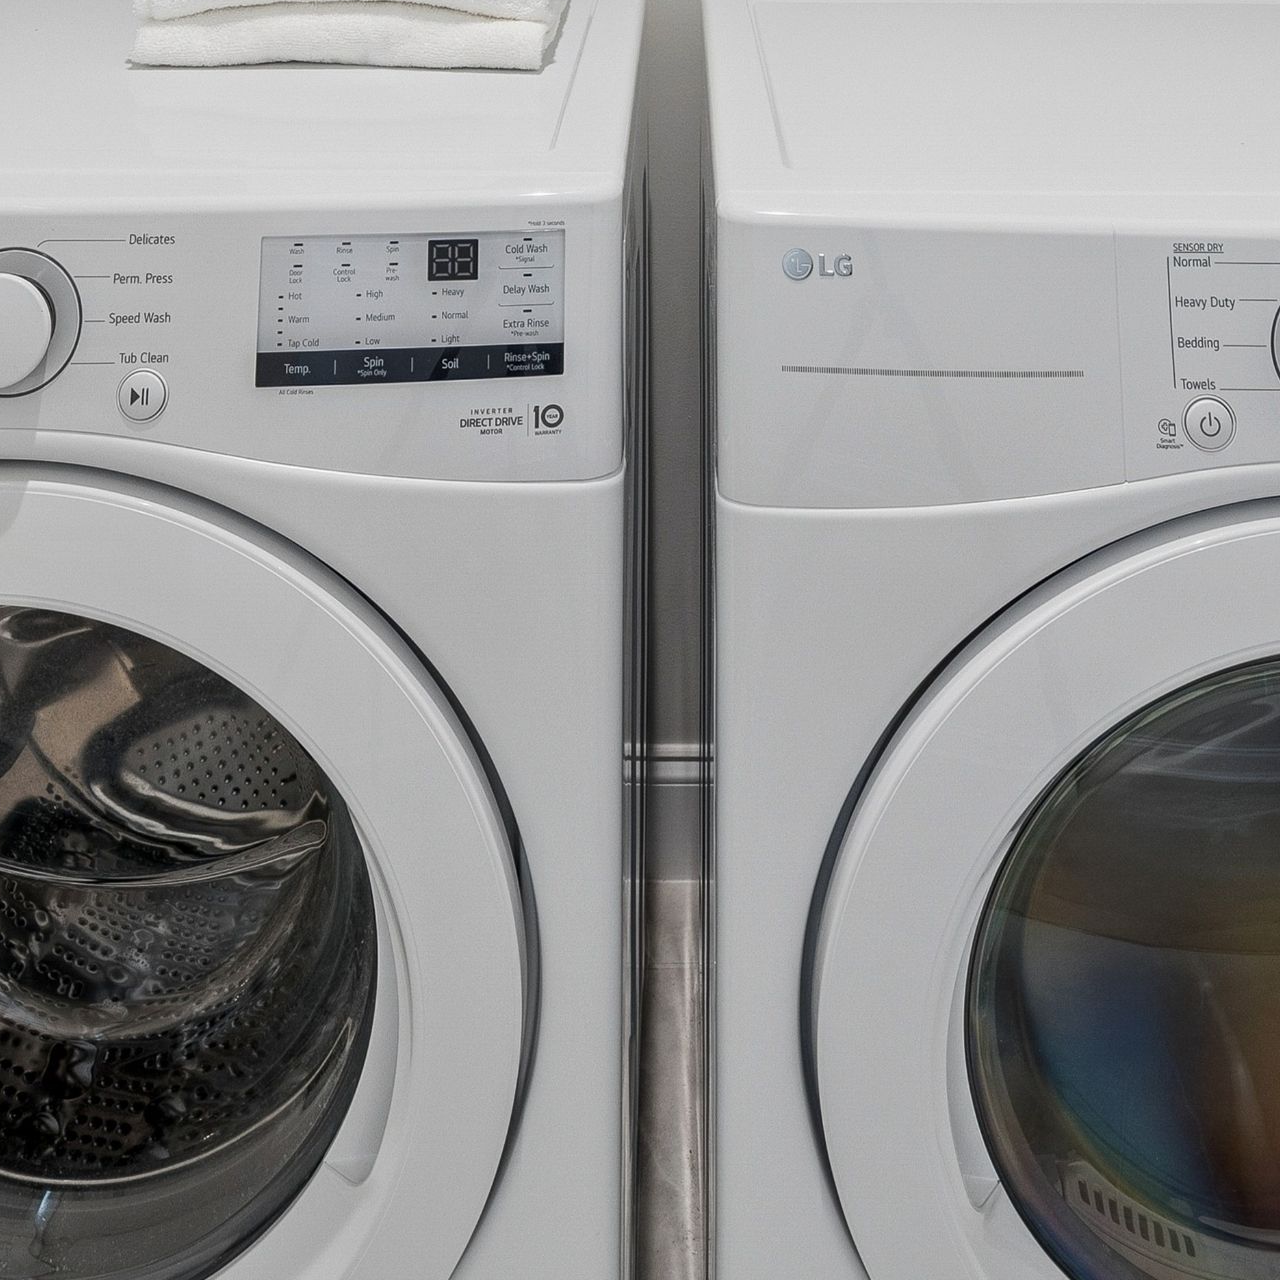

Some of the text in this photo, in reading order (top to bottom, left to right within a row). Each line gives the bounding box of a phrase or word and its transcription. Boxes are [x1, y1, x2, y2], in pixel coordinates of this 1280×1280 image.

[129, 234, 175, 245] Delicates
[506, 244, 548, 254] Cold Wash
[1173, 243, 1224, 253] SENSOR DRY
[818, 253, 853, 277] LG
[1173, 256, 1211, 268] Normal
[113, 273, 173, 285] Perm. Press
[288, 292, 302, 300] Hot
[366, 290, 383, 299] High
[442, 288, 464, 296] Heavy
[503, 284, 550, 296] Delay Wash
[1175, 296, 1235, 310] Heavy Duty
[109, 313, 171, 325] Speed Wash
[442, 311, 468, 319] Normal
[503, 319, 549, 328] Extra Rinse
[288, 340, 300, 348] Tap
[442, 335, 460, 344] Light
[1178, 337, 1220, 351] Bedding
[119, 352, 169, 364] Tub Clean
[364, 357, 384, 369] Spin
[505, 352, 550, 362] Rinse+Spin
[285, 363, 311, 376] Temp.
[442, 358, 459, 369] Soil
[1181, 379, 1216, 391] Towels
[460, 416, 523, 428] DIRECT DRIVE
[533, 404, 564, 428] 10
